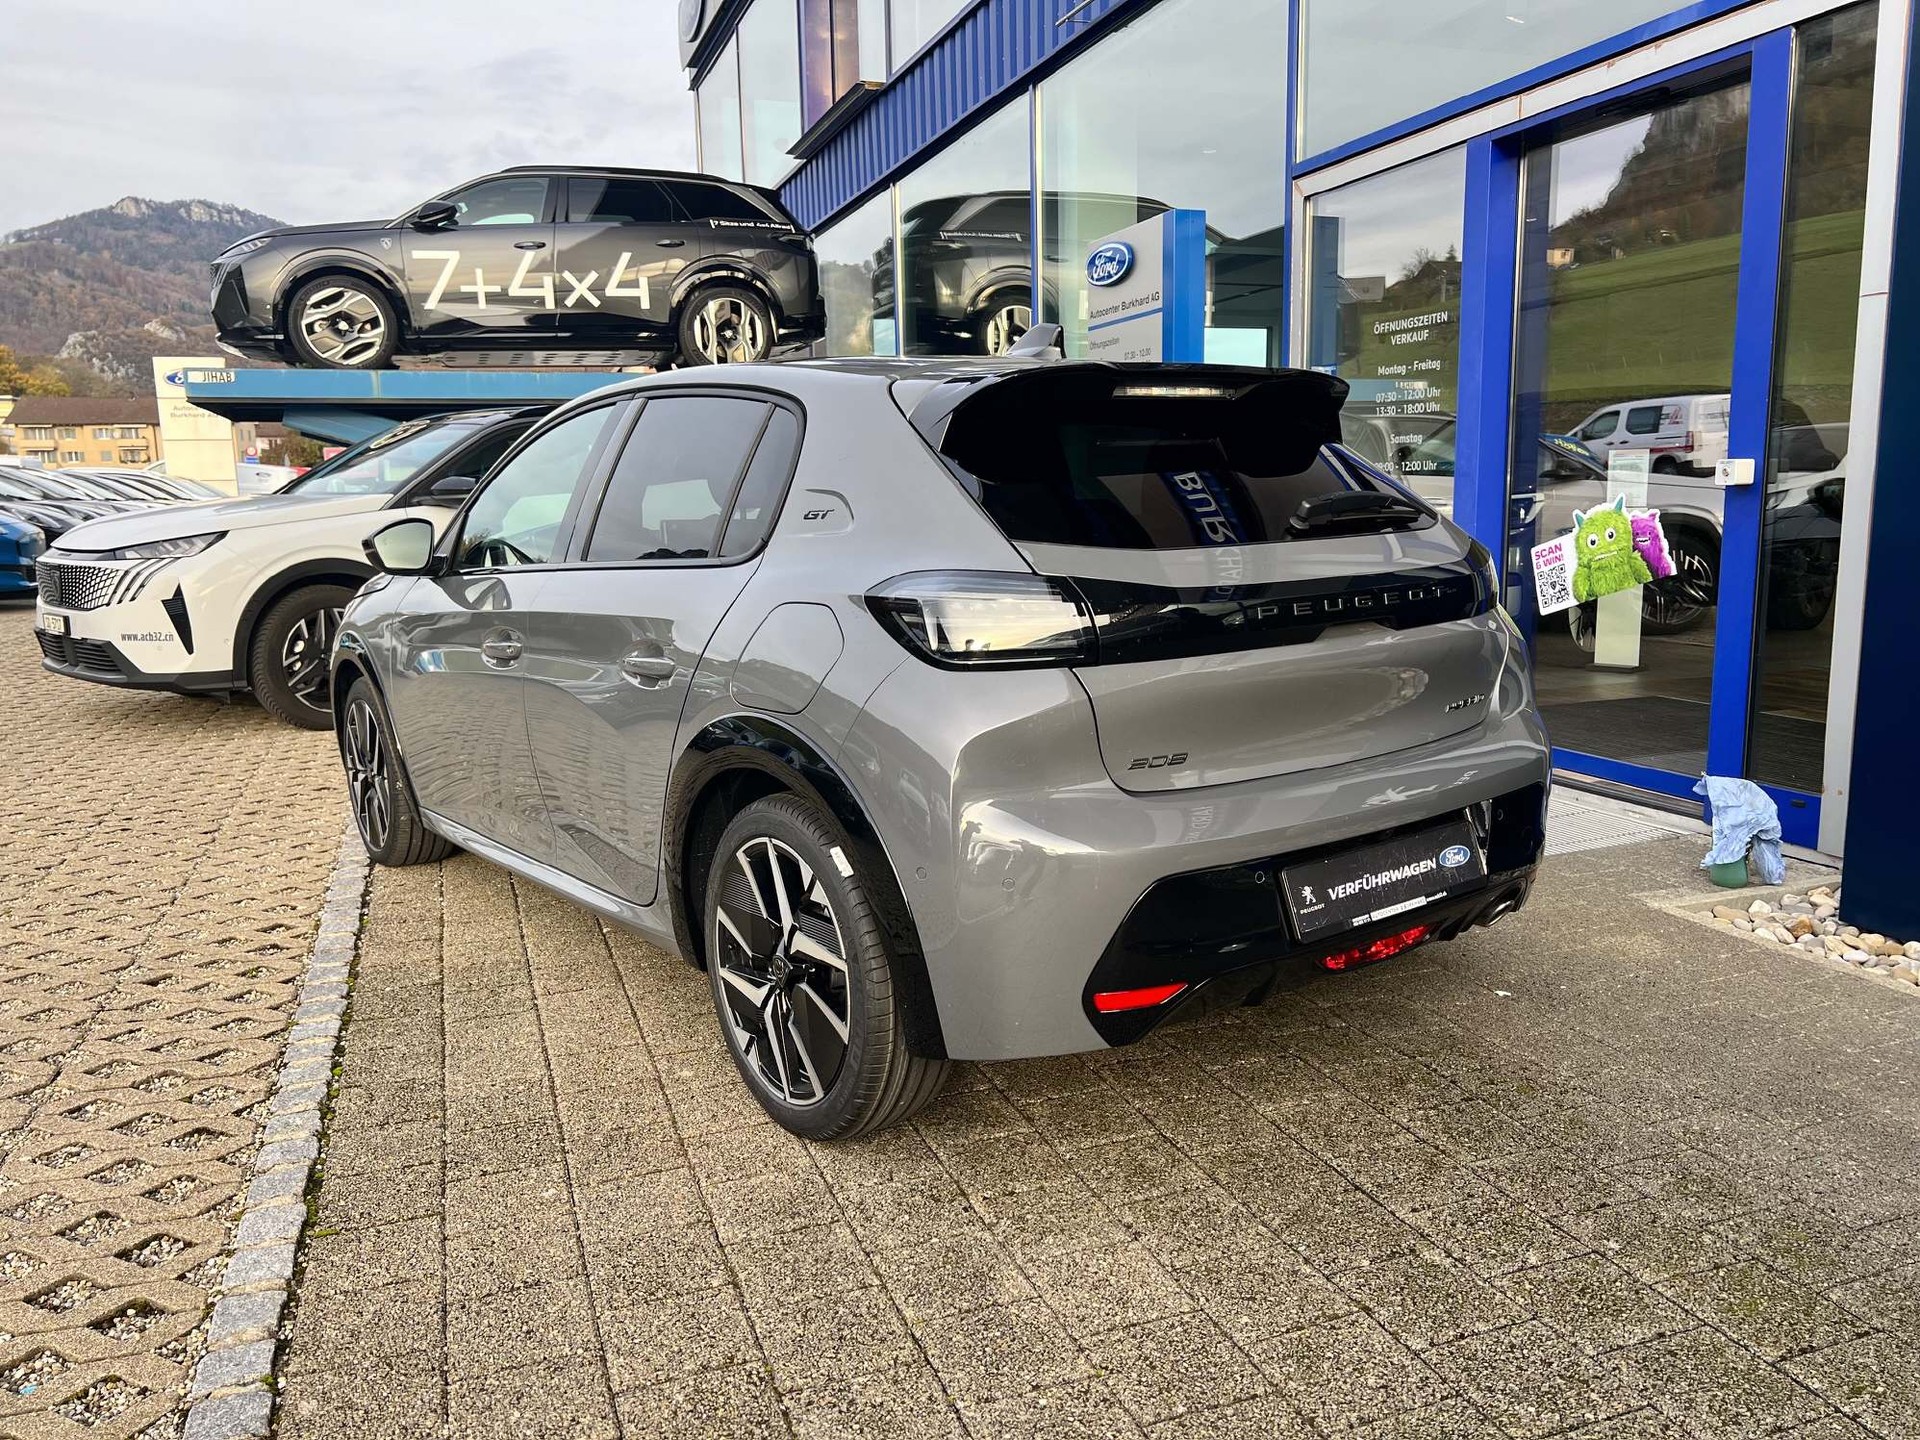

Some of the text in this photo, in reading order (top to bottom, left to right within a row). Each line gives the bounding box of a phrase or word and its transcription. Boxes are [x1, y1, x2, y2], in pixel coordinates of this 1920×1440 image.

[1093, 250, 1120, 282] Ford
[411, 250, 651, 310] 7+4x4
[1089, 292, 1160, 320] Autocenter Burkhard AG
[1373, 311, 1448, 335] ÖFFNUNGSZEITEN
[1390, 329, 1430, 346] VERKAUF
[1377, 364, 1407, 376] Montag
[1413, 358, 1441, 371] Freitag
[202, 371, 232, 383] JIHAB
[1375, 391, 1397, 404] 07:30
[1404, 388, 1426, 401] 12:00
[1426, 386, 1441, 398] Uhr
[1375, 405, 1397, 417] 13:30
[1403, 402, 1425, 415] 18:00
[1425, 401, 1441, 413] Uhr
[1390, 433, 1423, 445] Samstag
[1401, 461, 1422, 471] 12:00
[1423, 460, 1438, 471] Uhr
[803, 509, 835, 520] GT
[1534, 542, 1562, 561] SCAN
[1543, 553, 1564, 567] WIN!
[1257, 586, 1444, 619] PEUGEOT
[1127, 752, 1189, 771] 208
[1327, 849, 1465, 901] VERFÜHRWAGEN Ford
[1300, 903, 1325, 915] PEUGEOT
